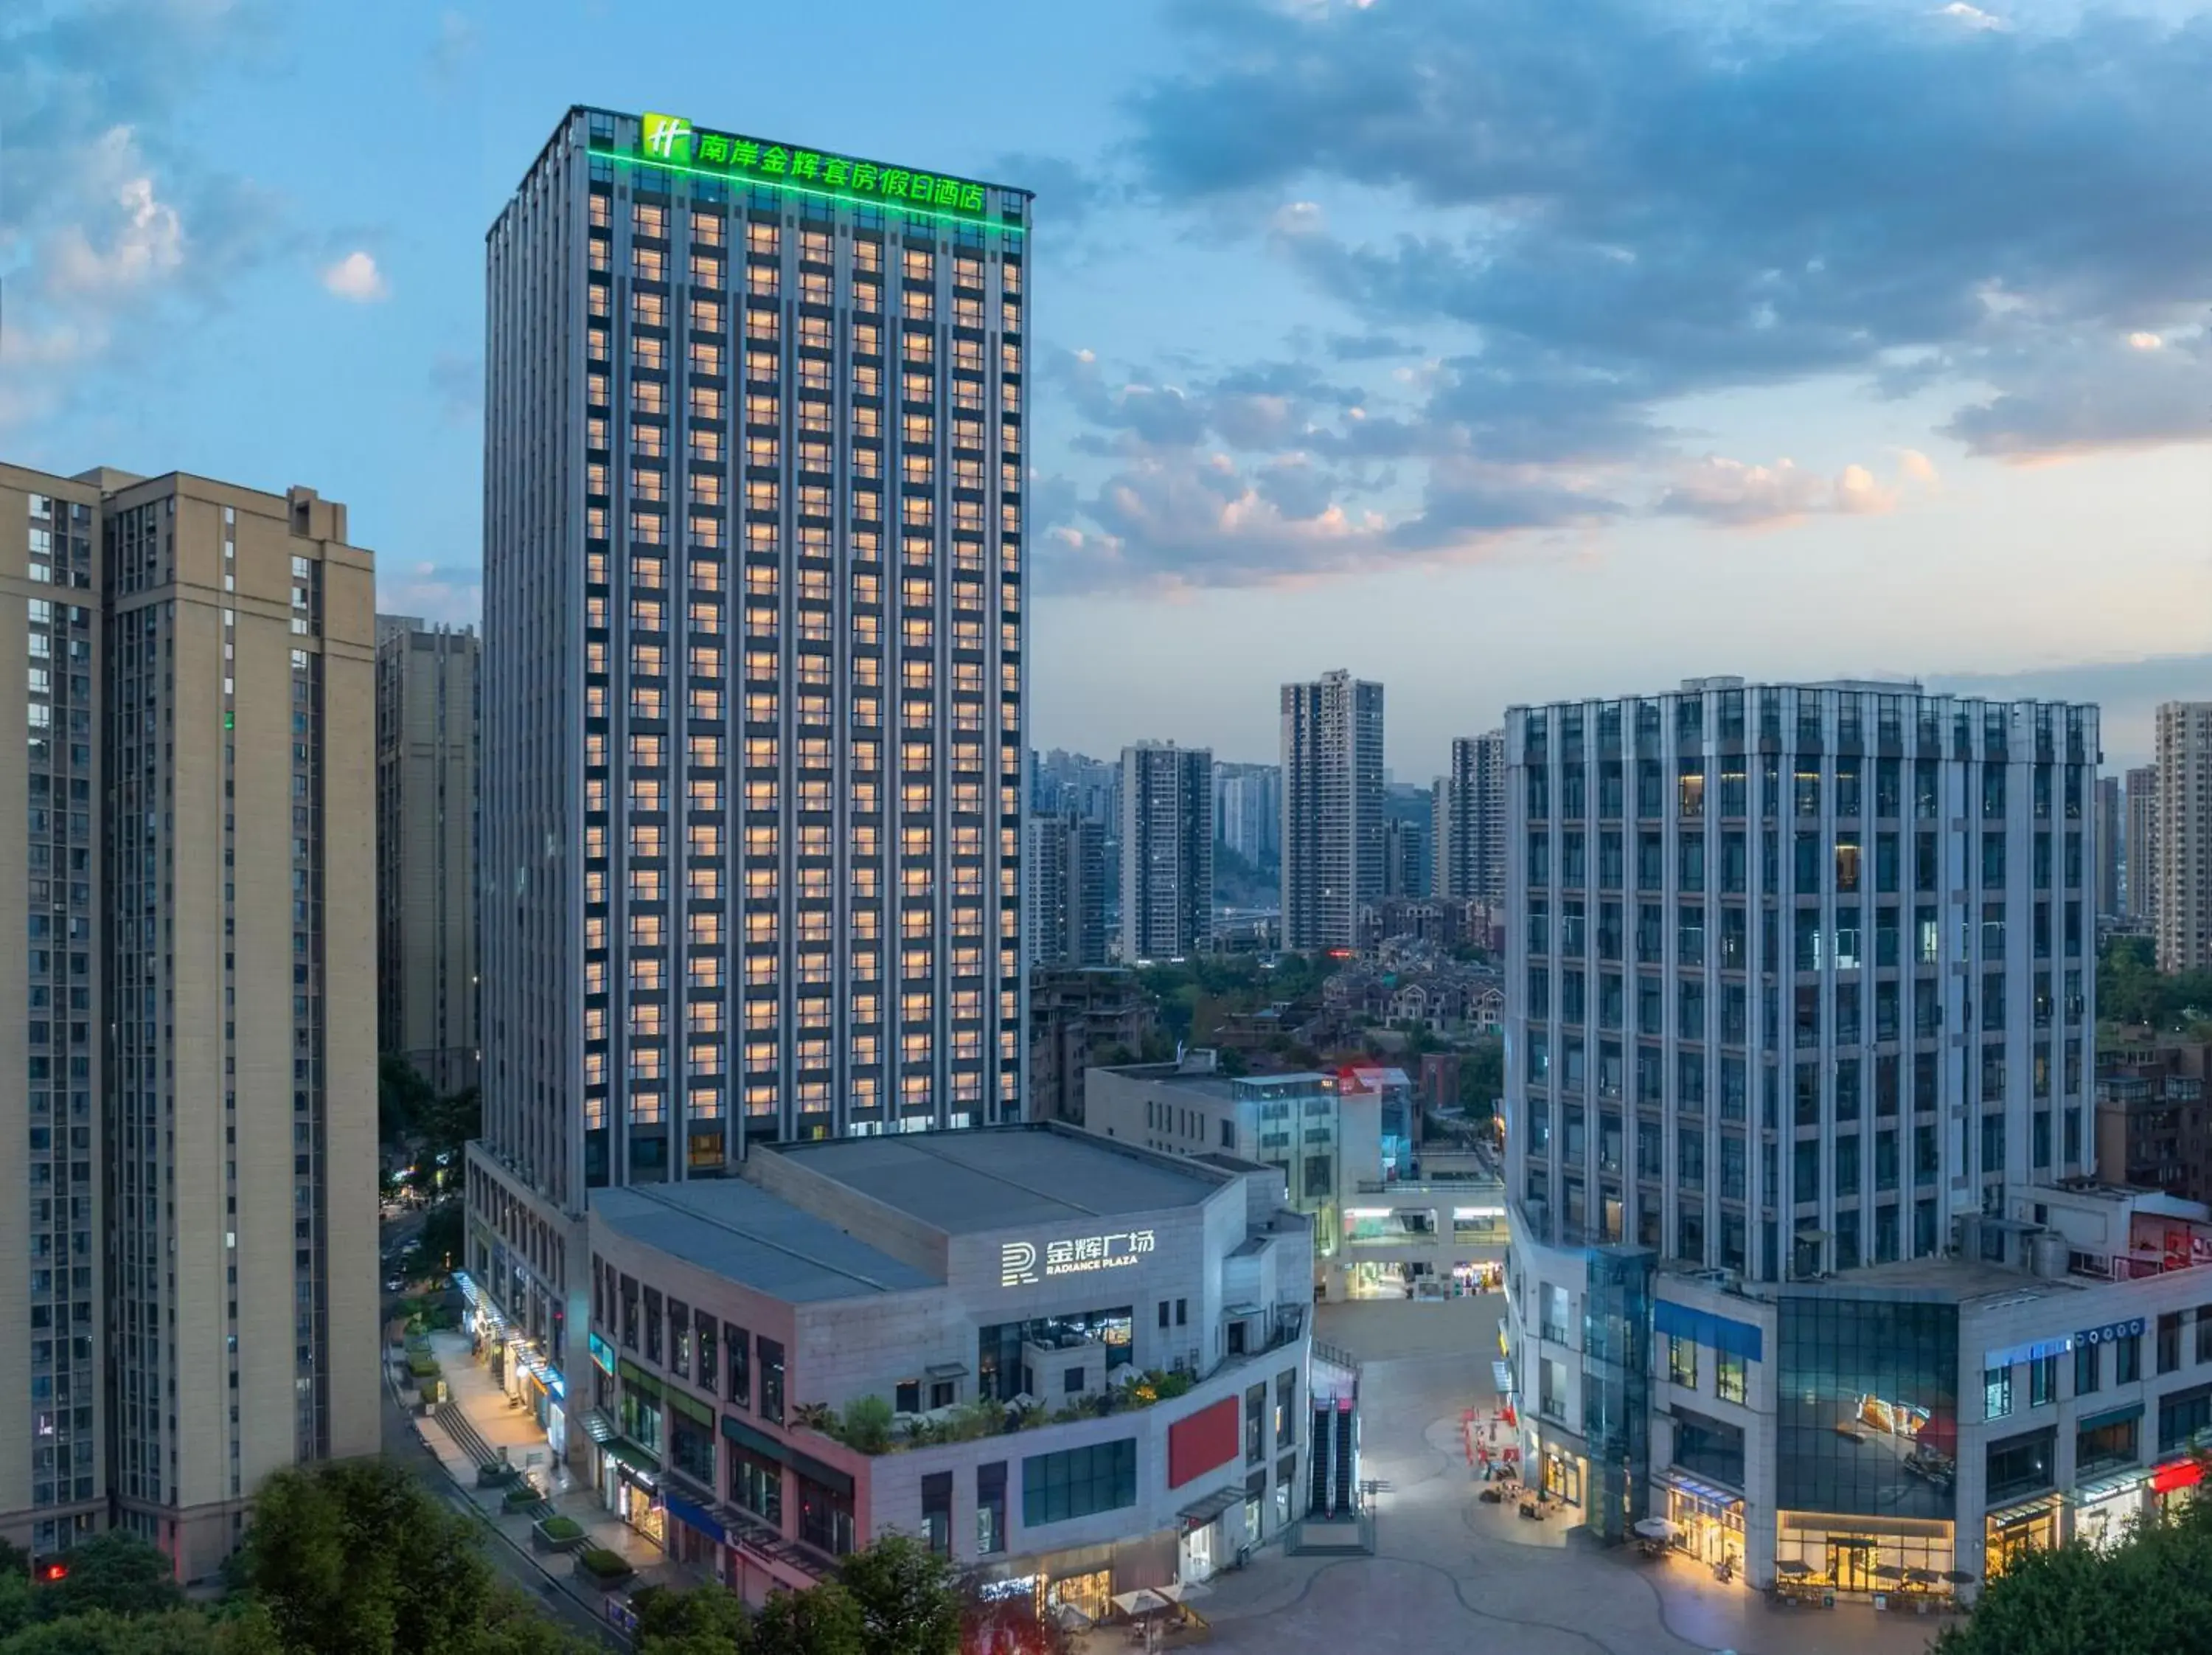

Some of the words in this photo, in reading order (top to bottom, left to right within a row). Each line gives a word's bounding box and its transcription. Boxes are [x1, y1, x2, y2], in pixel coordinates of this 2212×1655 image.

[699, 133, 985, 212] 南岸金辉套房假日酒店
[1046, 1229, 1154, 1263] 金辉广场
[1046, 1260, 1100, 1274] RADIANCE
[1103, 1255, 1138, 1267] PLAZA
